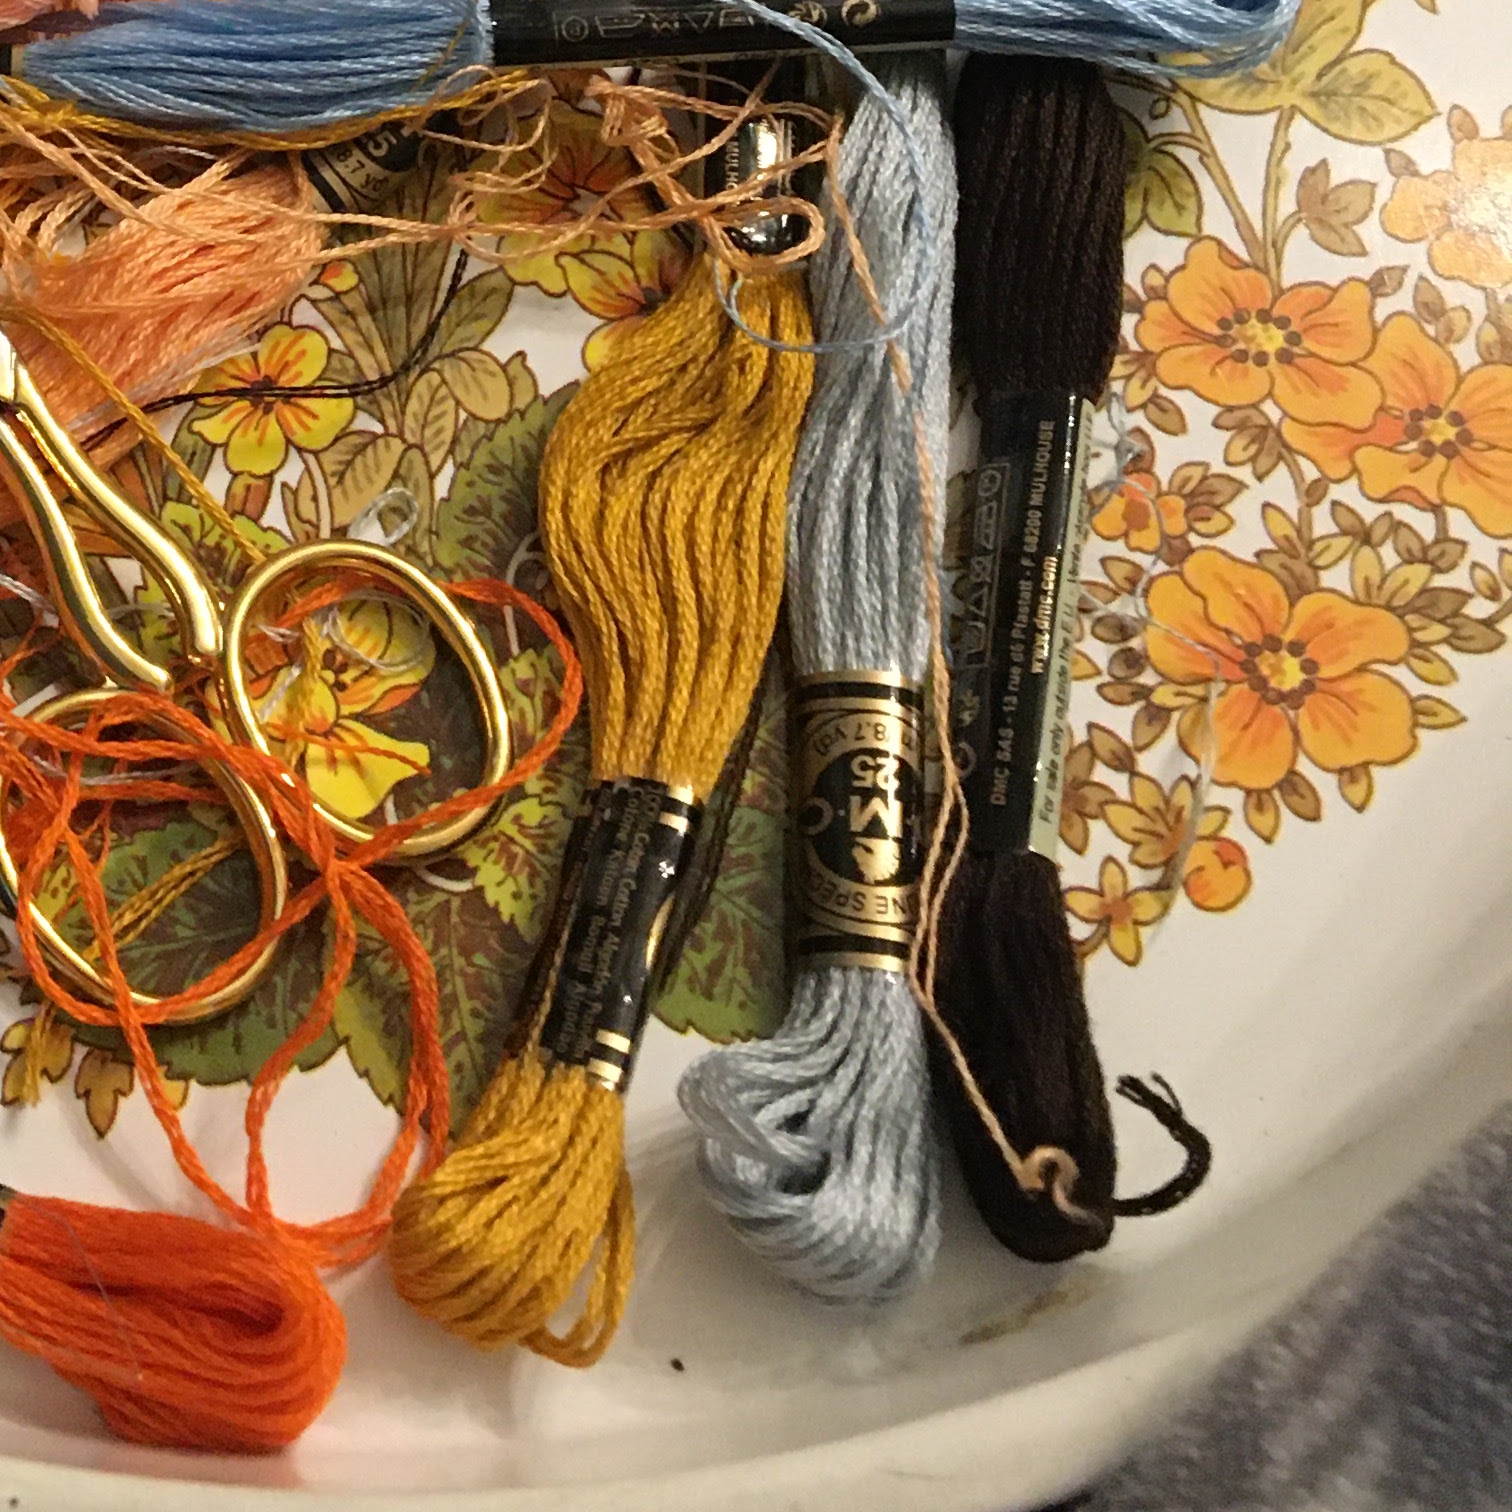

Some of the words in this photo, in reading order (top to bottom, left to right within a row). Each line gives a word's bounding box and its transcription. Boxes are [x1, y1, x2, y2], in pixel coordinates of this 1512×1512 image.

[989, 764, 1011, 805] DMC
[1028, 418, 1057, 507] MULHOUSE
[847, 753, 899, 791] 25
